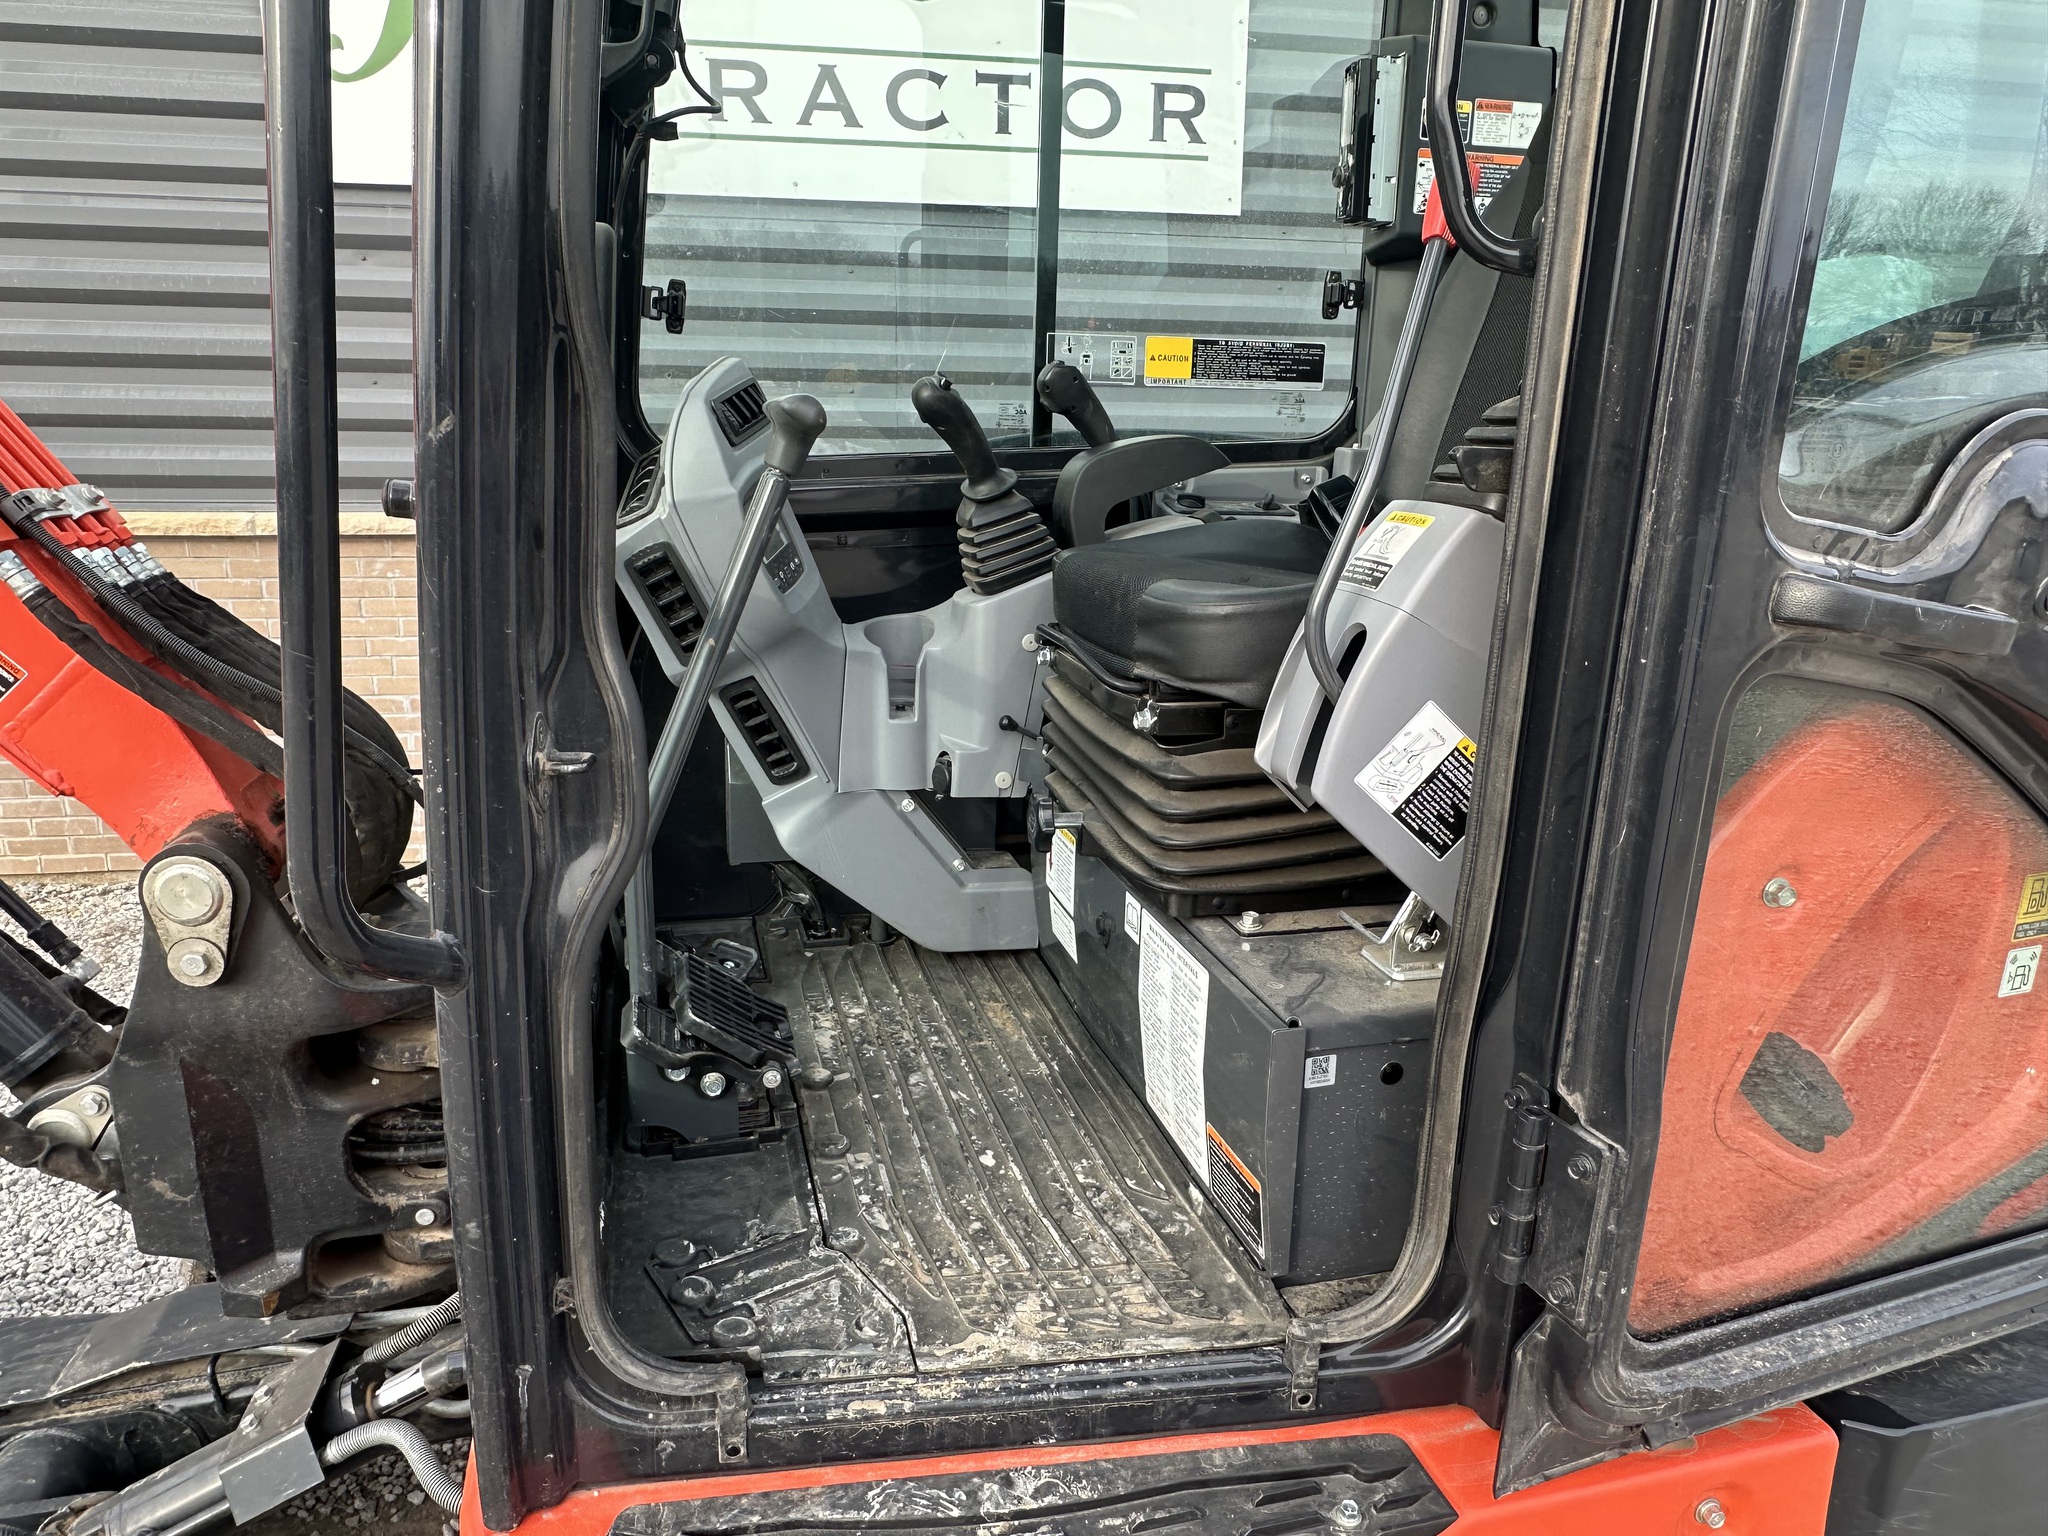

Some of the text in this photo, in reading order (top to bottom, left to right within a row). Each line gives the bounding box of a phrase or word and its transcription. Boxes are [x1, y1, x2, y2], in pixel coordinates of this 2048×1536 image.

[1485, 103, 1511, 111] WARNING
[1158, 354, 1189, 363] CAUTION
[1150, 377, 1187, 386] IMPORTANT
[1397, 513, 1428, 525] CAUTION
